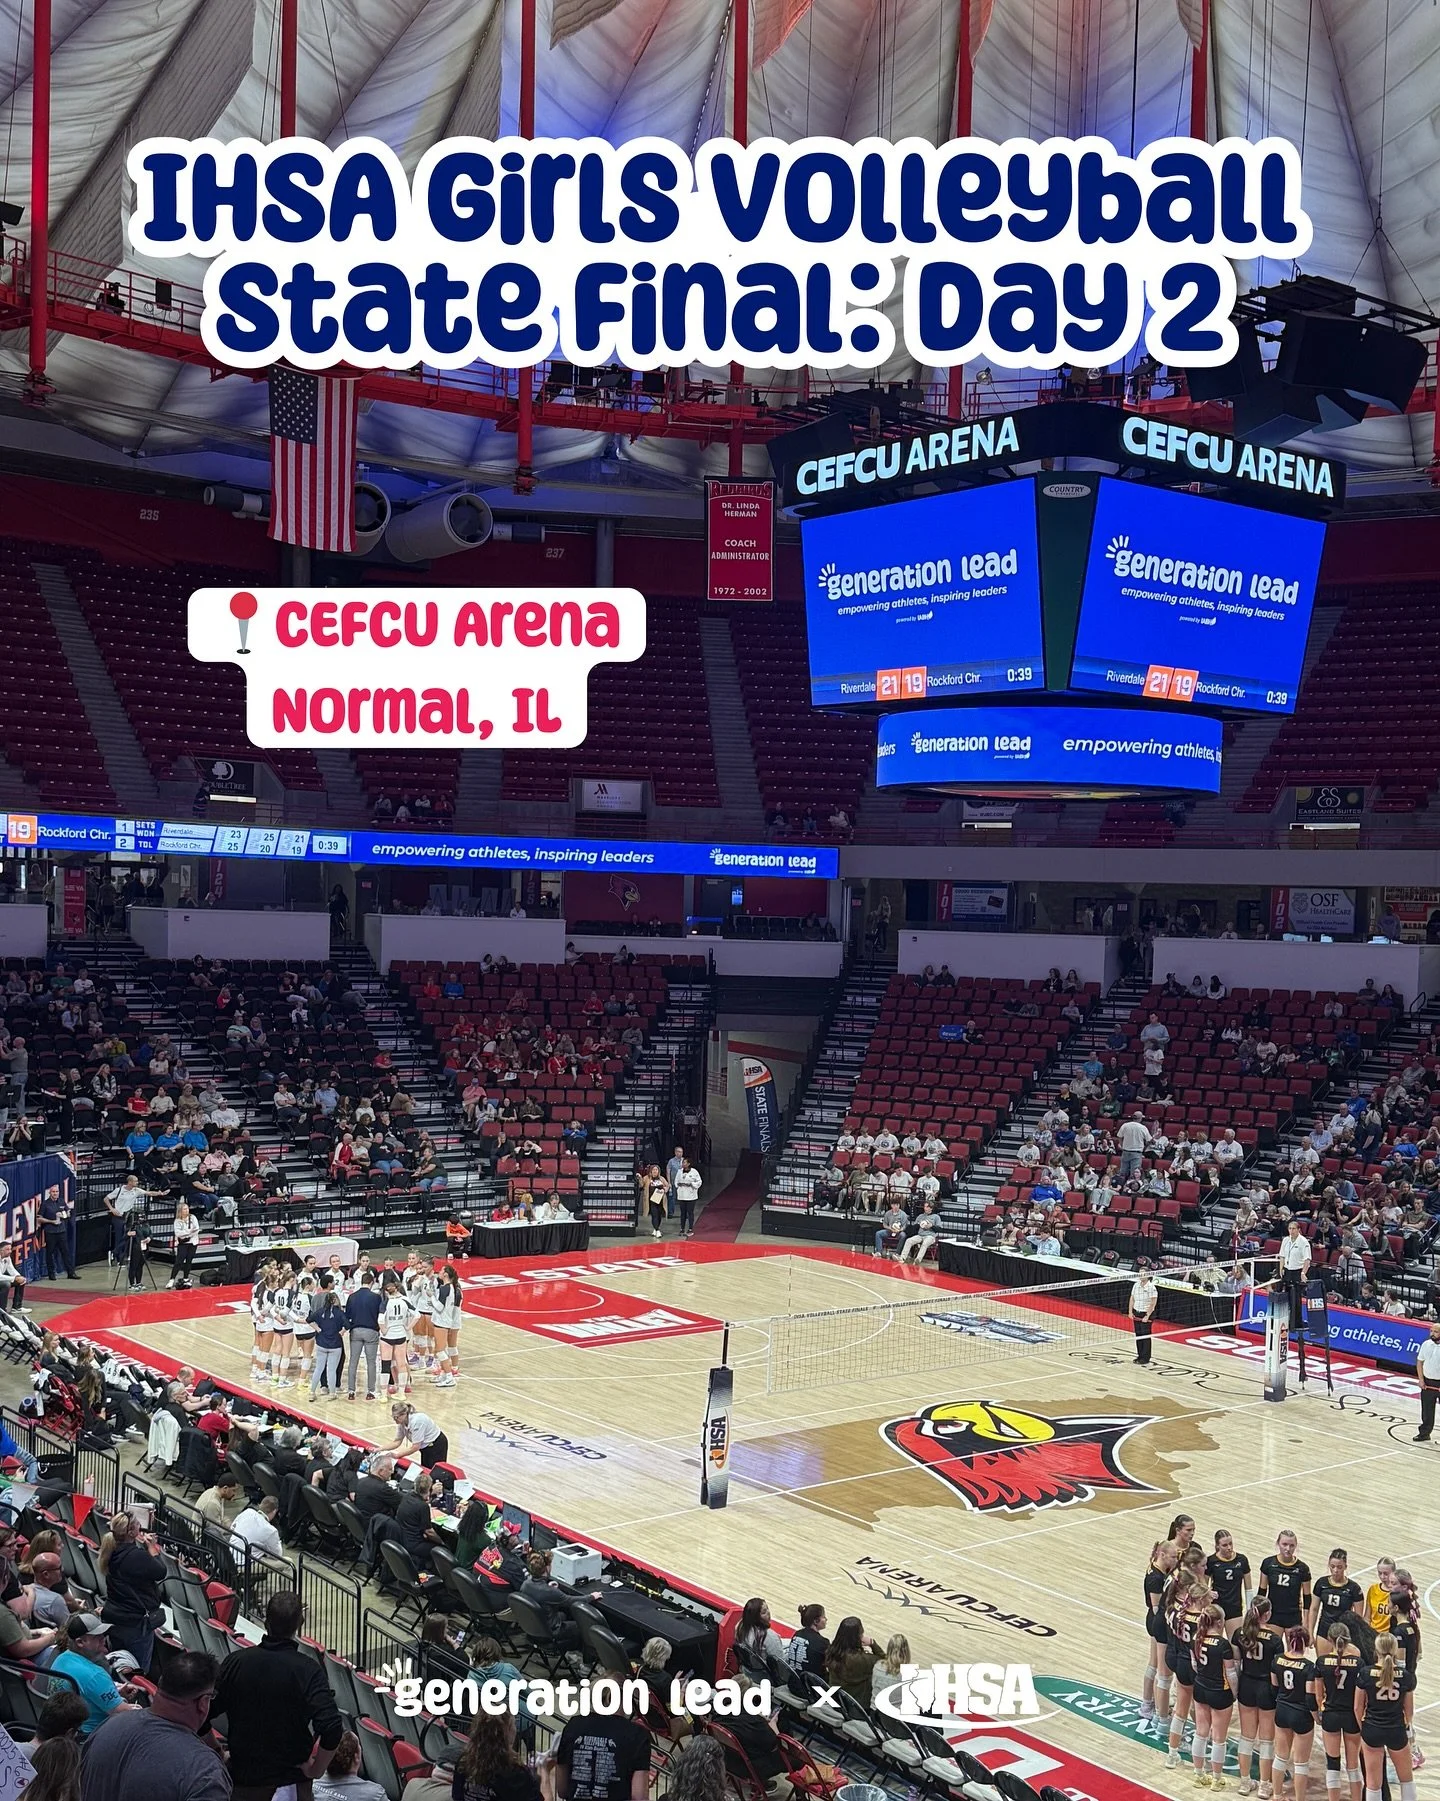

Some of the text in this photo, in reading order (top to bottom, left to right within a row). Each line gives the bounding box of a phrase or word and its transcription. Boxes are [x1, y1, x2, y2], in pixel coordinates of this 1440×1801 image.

[796, 416, 1019, 495] CEFCU ARENA
[1122, 416, 1335, 498] CEFCU ARENA
[737, 502, 760, 510] LINDA
[140, 509, 159, 520] 235
[546, 548, 565, 558] 237
[711, 552, 769, 560] ADMINISTRATOR
[827, 549, 1017, 600] generation lead
[1114, 549, 1300, 605] generation lead
[714, 587, 735, 595] 1972
[744, 588, 767, 596] 2002
[838, 585, 1007, 615] empowering athletes, inspiring leaders
[1121, 587, 1285, 621] empowering athletes, inspiring leaders
[841, 667, 1032, 695] Riverdale 21 19 Rockford Chr. 0:39
[1106, 670, 1287, 705] Riverdale 21 19 Rockford Chr. 0:39
[915, 735, 988, 753] generation
[994, 735, 1031, 751] lead
[1063, 738, 1171, 758] empowering
[1174, 743, 1215, 763] athletes,
[8, 821, 31, 839] 19
[38, 826, 87, 839] Rockford
[89, 828, 111, 840] Chr.
[122, 823, 127, 832] 1
[136, 821, 155, 829] SETS
[137, 829, 155, 837] WON
[120, 839, 127, 848] 2
[138, 840, 153, 848] TOL
[230, 830, 242, 839] 23
[264, 833, 275, 841] 25
[294, 834, 305, 843] 21
[227, 842, 239, 851] 25
[260, 845, 271, 853] 20
[291, 846, 302, 855] 19
[318, 840, 339, 850] 0:39
[372, 842, 654, 864] empowering athletes, inspiring leaders
[714, 850, 816, 868] generation lead
[1311, 893, 1339, 907] OSF
[755, 1086, 771, 1153] STATE FINALS
[520, 1257, 697, 1280] STATE
[278, 1296, 285, 1307] 10
[394, 1304, 401, 1316] 11
[1343, 1327, 1402, 1352] athletes,
[480, 1411, 607, 1460] CEFCU ARENA
[710, 1416, 726, 1461] IHSA
[1225, 1570, 1233, 1580] 2
[1276, 1574, 1290, 1587] 12
[855, 1556, 1058, 1637] CEFCU ARENA
[1327, 1594, 1340, 1607] 13
[1378, 1603, 1390, 1616] 60
[1324, 1658, 1358, 1667] RIVEDALE
[1283, 1670, 1294, 1690] 8
[1336, 1670, 1348, 1690] 7
[1376, 1682, 1400, 1701] 26
